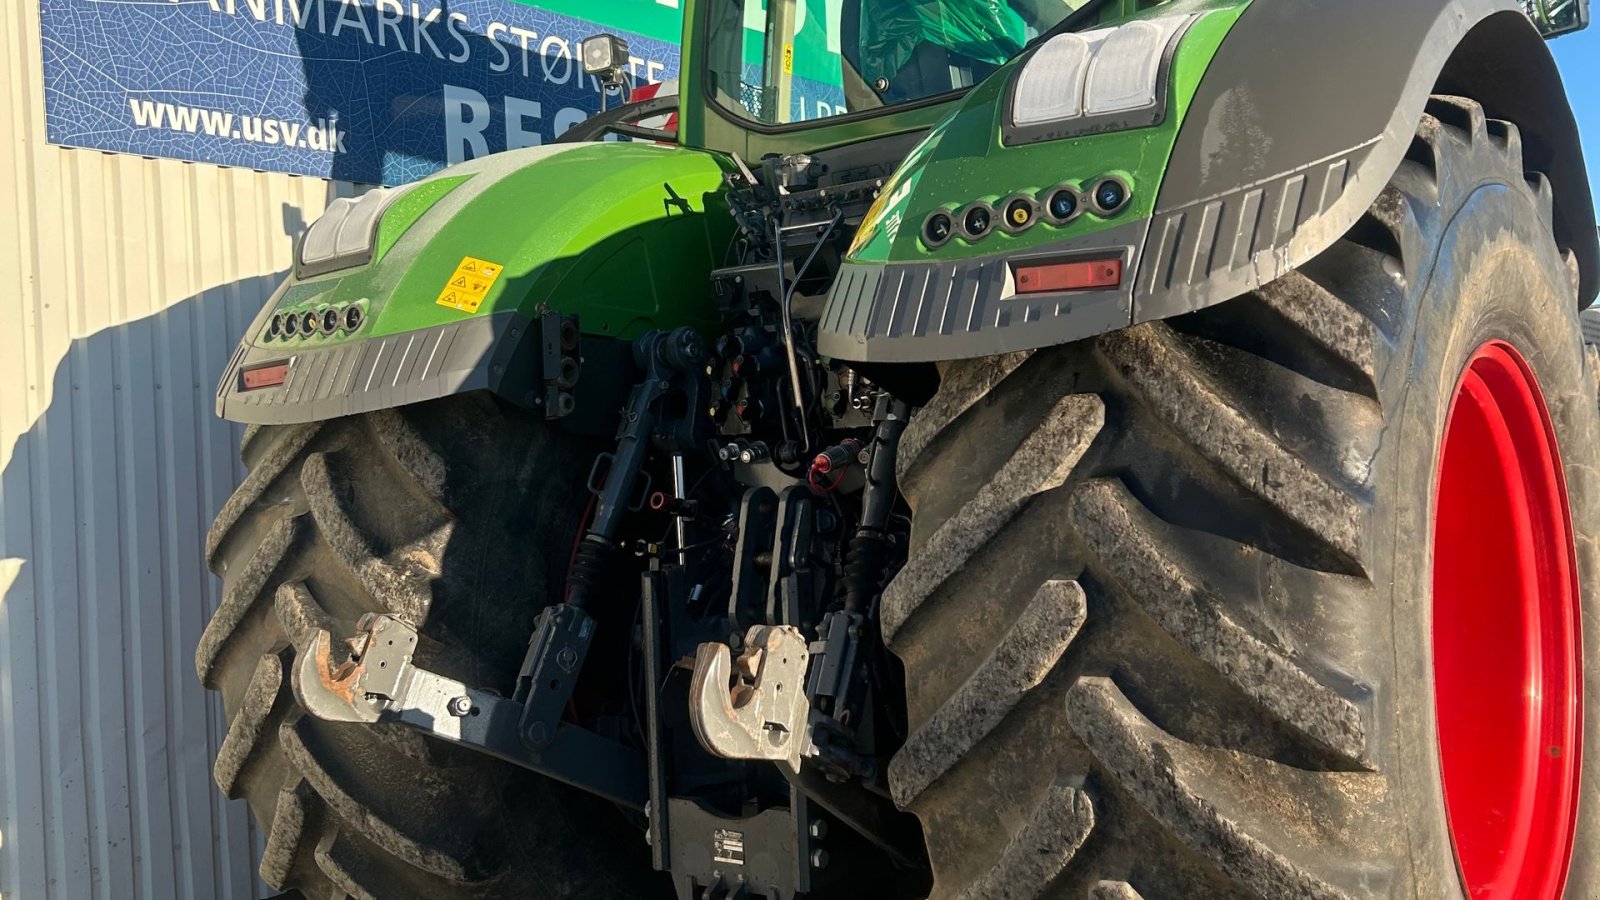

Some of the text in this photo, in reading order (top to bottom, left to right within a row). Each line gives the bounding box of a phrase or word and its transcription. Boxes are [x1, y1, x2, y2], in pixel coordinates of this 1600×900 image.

[170, 0, 470, 63] MARKS
[487, 22, 665, 95] STØTE
[129, 98, 347, 154] www.usv.dk
